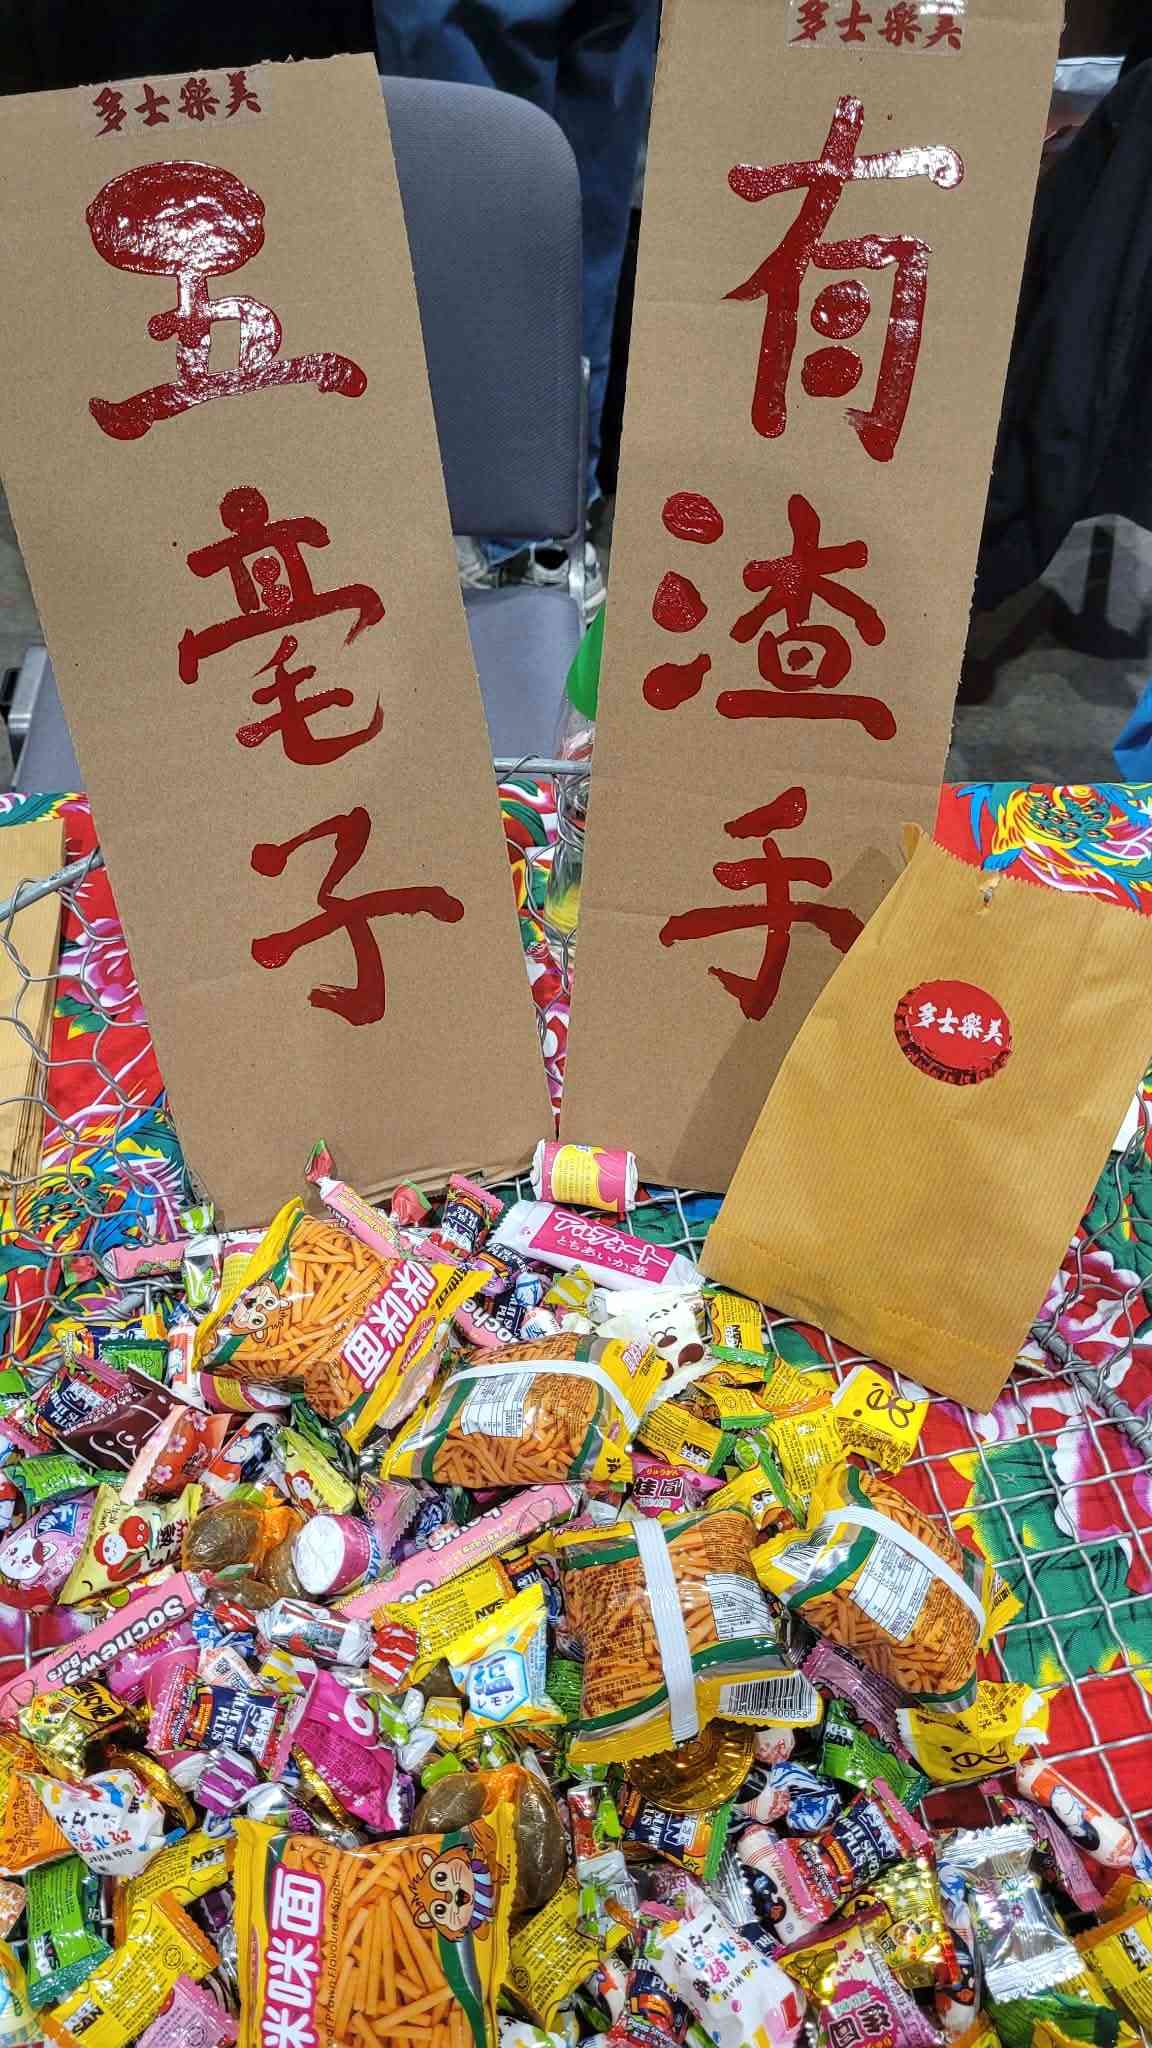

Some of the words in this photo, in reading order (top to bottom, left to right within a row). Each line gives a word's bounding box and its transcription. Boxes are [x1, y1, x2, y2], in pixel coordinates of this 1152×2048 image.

[92, 70, 262, 137] 多士樂美
[913, 1002, 1004, 1045] 多士樂美
[341, 1258, 437, 1391] 咪咪面
[458, 1296, 515, 1346] oche
